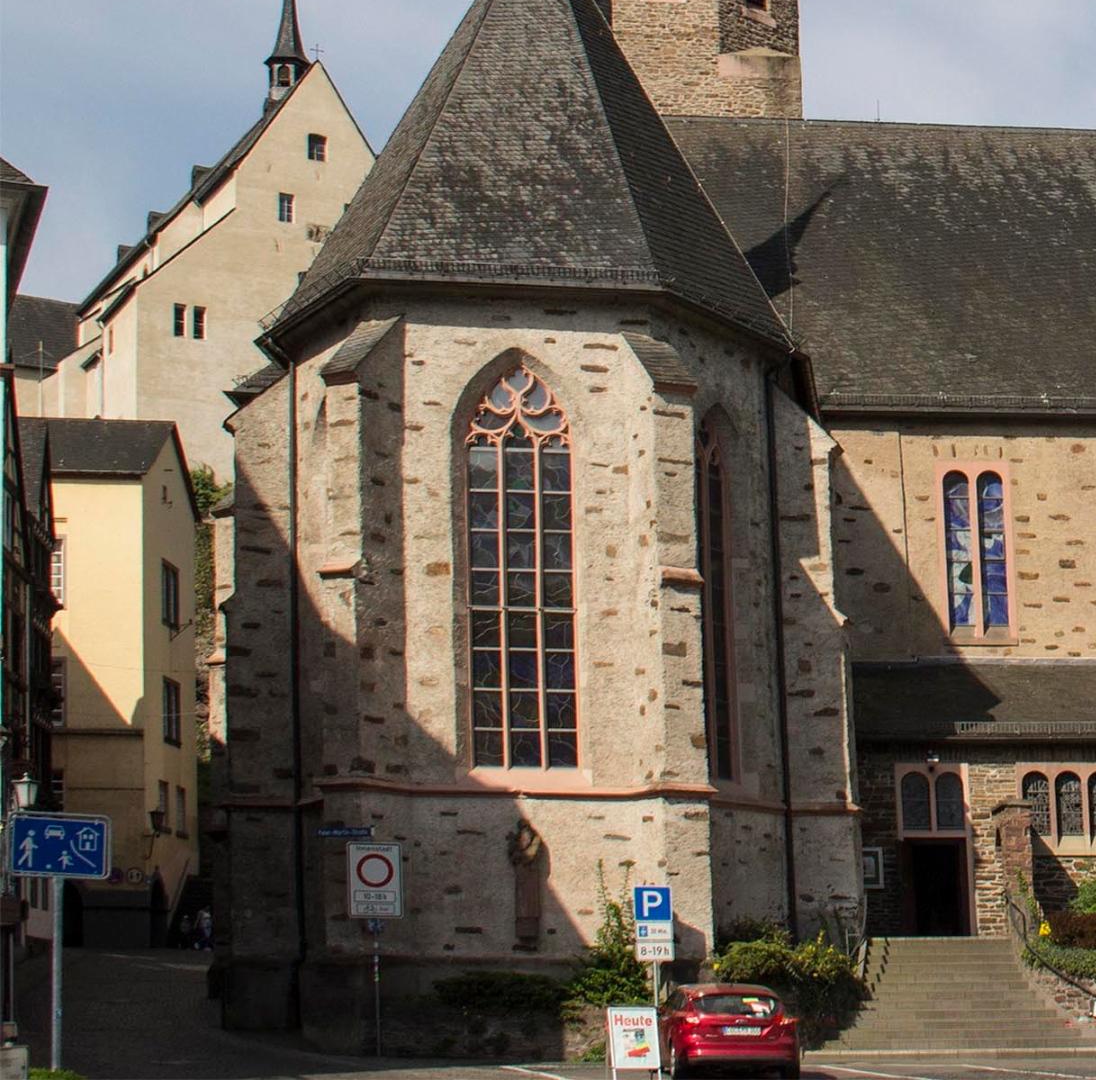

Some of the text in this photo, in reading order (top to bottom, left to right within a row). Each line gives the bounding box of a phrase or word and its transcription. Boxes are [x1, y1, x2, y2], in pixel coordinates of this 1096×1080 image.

[642, 890, 663, 917] P
[640, 946, 662, 956] 8-19
[614, 1014, 653, 1027] Heute
